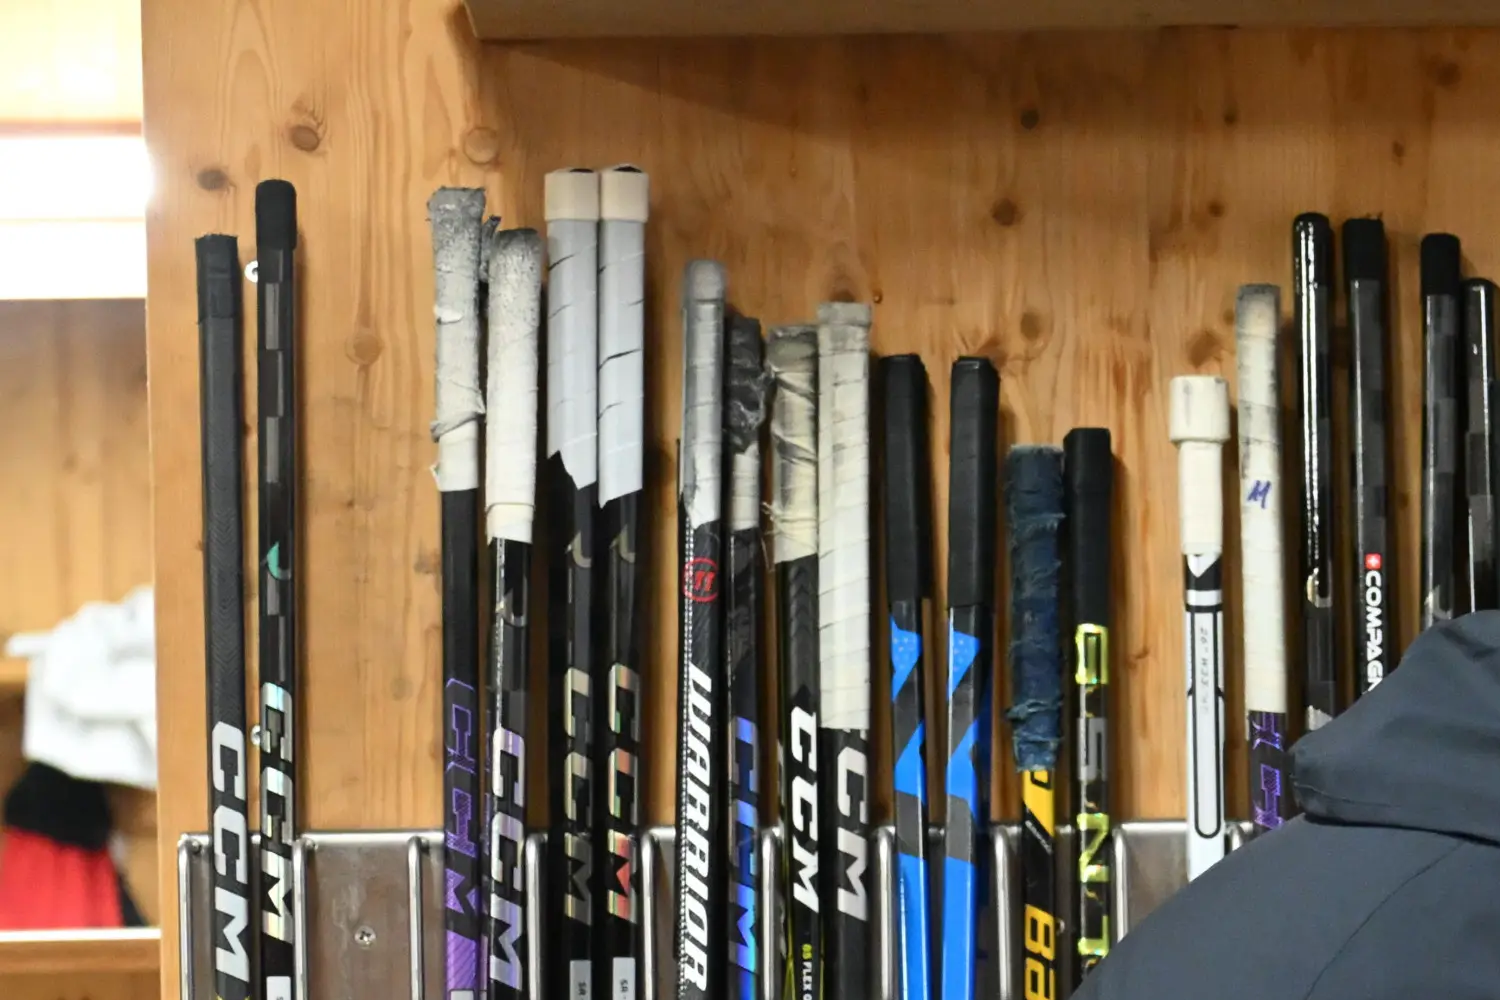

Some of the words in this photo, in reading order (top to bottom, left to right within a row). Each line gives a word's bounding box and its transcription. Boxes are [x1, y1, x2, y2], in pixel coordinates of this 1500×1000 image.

[211, 720, 249, 983] CCM
[260, 683, 293, 942] CCM
[445, 677, 477, 945] CCM
[489, 727, 524, 991] CCM
[564, 667, 592, 926] CCM
[607, 663, 640, 926] CCM
[683, 661, 712, 992] WARRIOR
[729, 716, 760, 977] CCM
[790, 706, 820, 914] CCM
[837, 729, 868, 922] CM
[803, 961, 813, 991] FLEX
